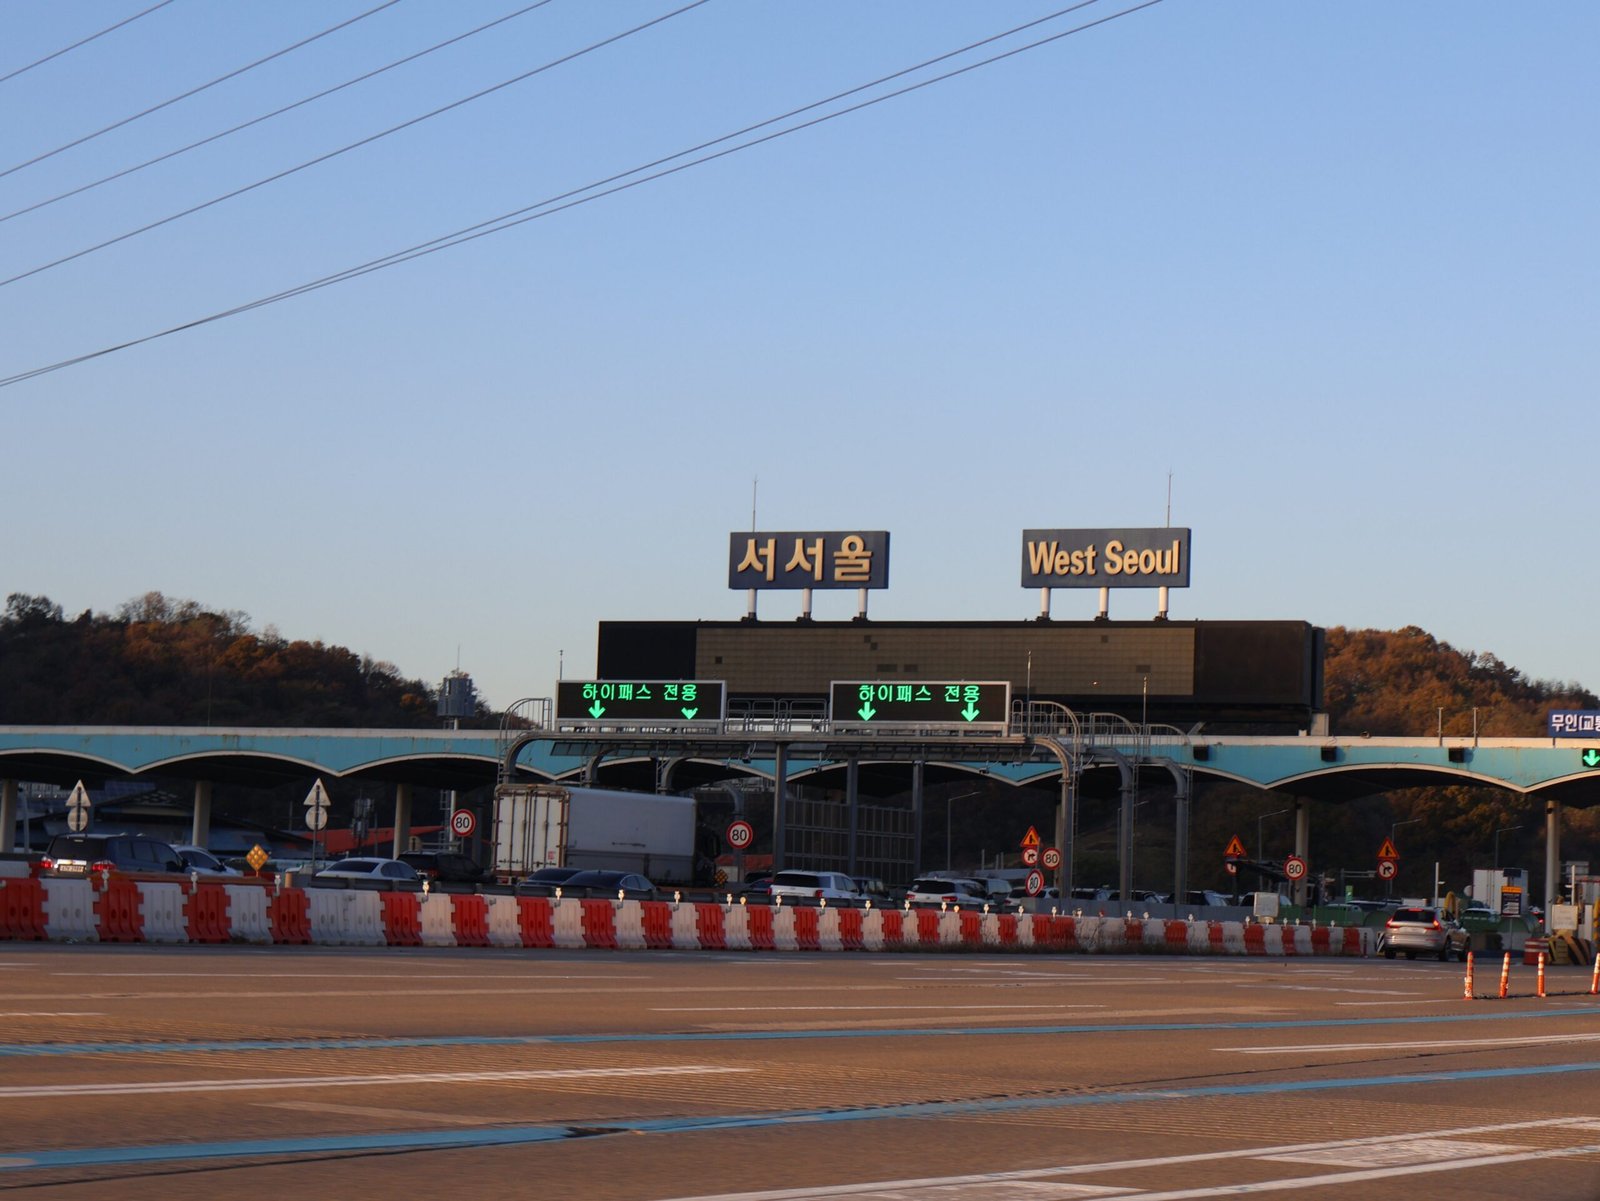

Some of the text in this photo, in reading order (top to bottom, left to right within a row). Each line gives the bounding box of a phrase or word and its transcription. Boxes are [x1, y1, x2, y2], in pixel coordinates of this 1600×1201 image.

[737, 535, 873, 582] 서서울
[1027, 540, 1181, 576] West Seoul
[582, 684, 697, 701] 하이패스 전용
[859, 685, 980, 703] 하이패스 전용
[455, 816, 470, 829] 80
[731, 829, 747, 841] 80
[1045, 853, 1058, 864] 80
[1288, 864, 1302, 874] 80
[1029, 877, 1039, 889] 80
